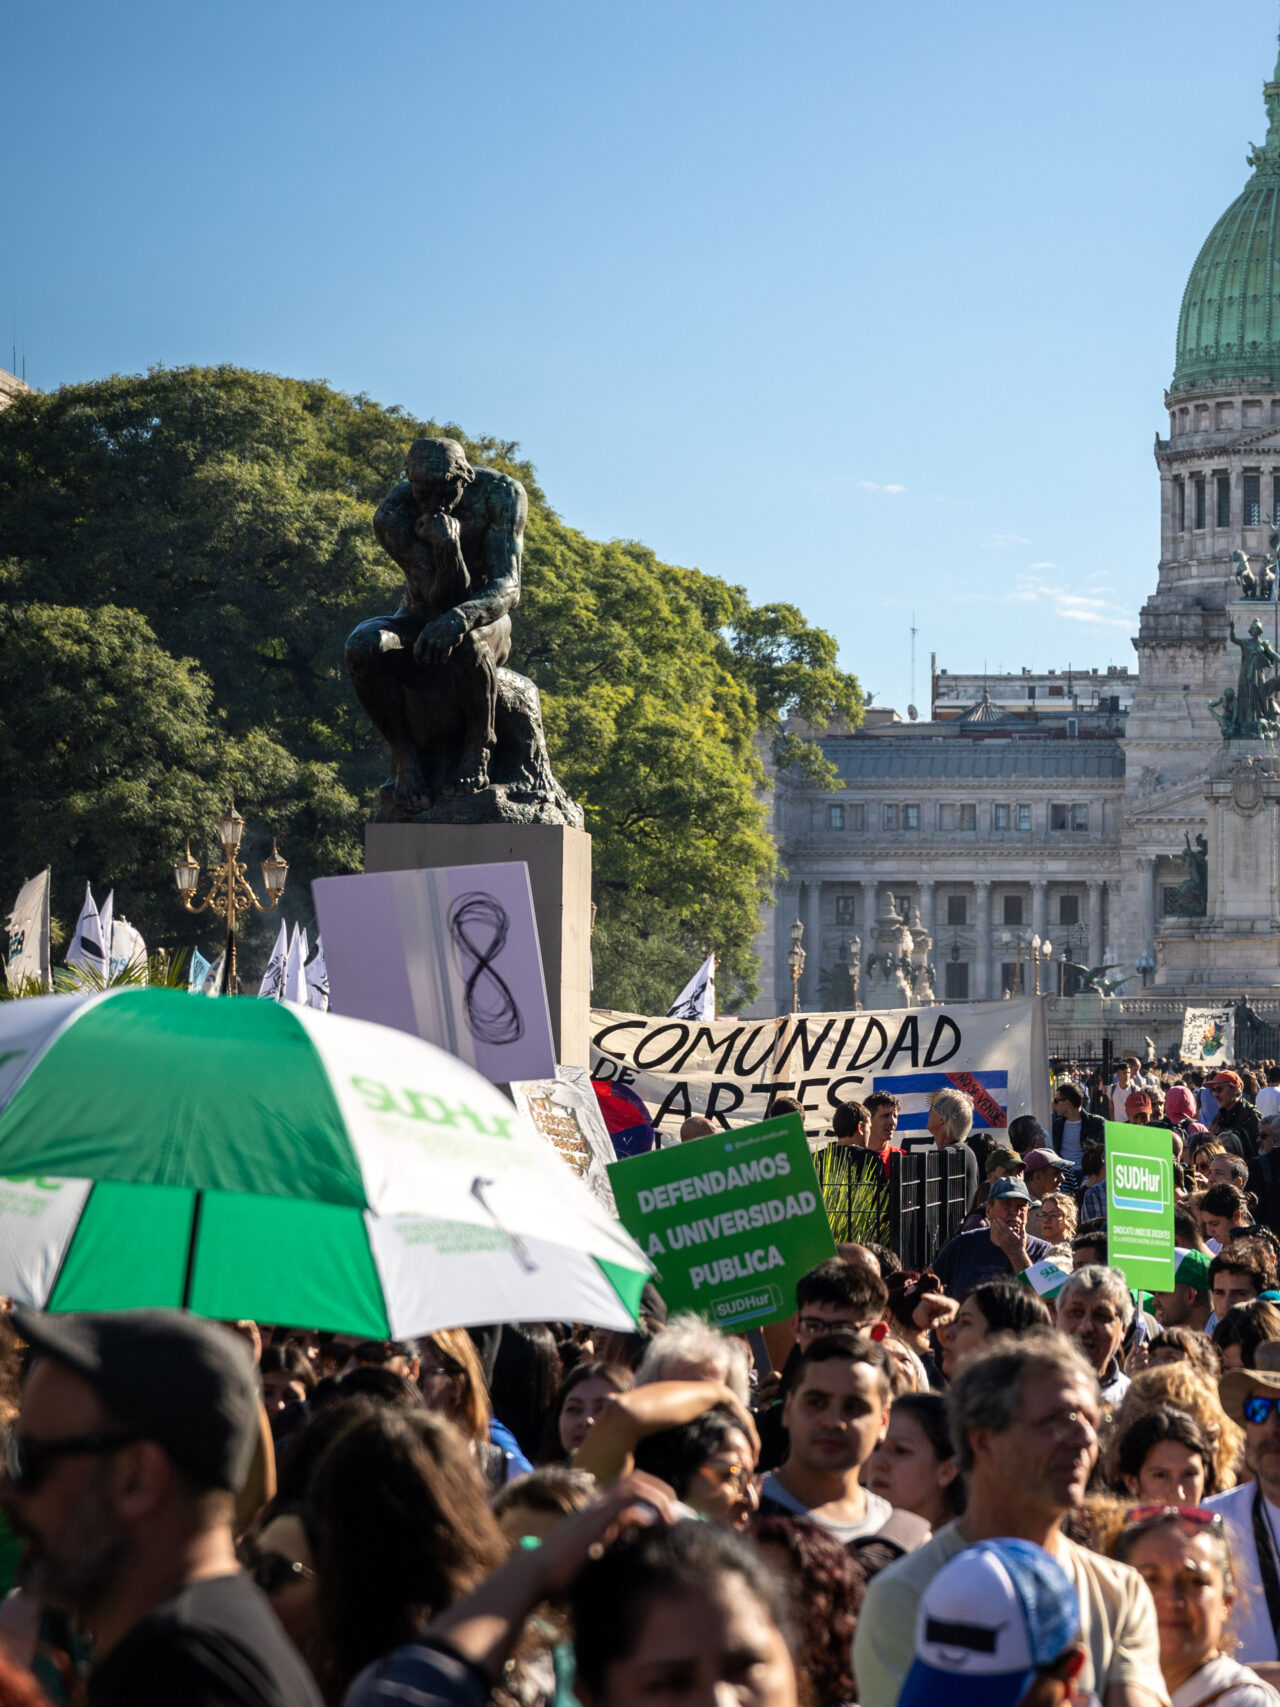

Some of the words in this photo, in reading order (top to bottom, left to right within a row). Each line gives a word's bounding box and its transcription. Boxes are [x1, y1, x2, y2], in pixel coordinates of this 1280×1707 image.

[593, 1015, 961, 1076] COMUNIDAD
[591, 1056, 640, 1085] DE
[956, 1073, 972, 1087] NO
[637, 1152, 791, 1214] DEFENDAMOS
[1115, 1163, 1160, 1193] SUDHur
[667, 1190, 817, 1250] UNIVERSIDAD
[689, 1245, 785, 1291] PUBLICA
[716, 1292, 769, 1317] SUDHur
